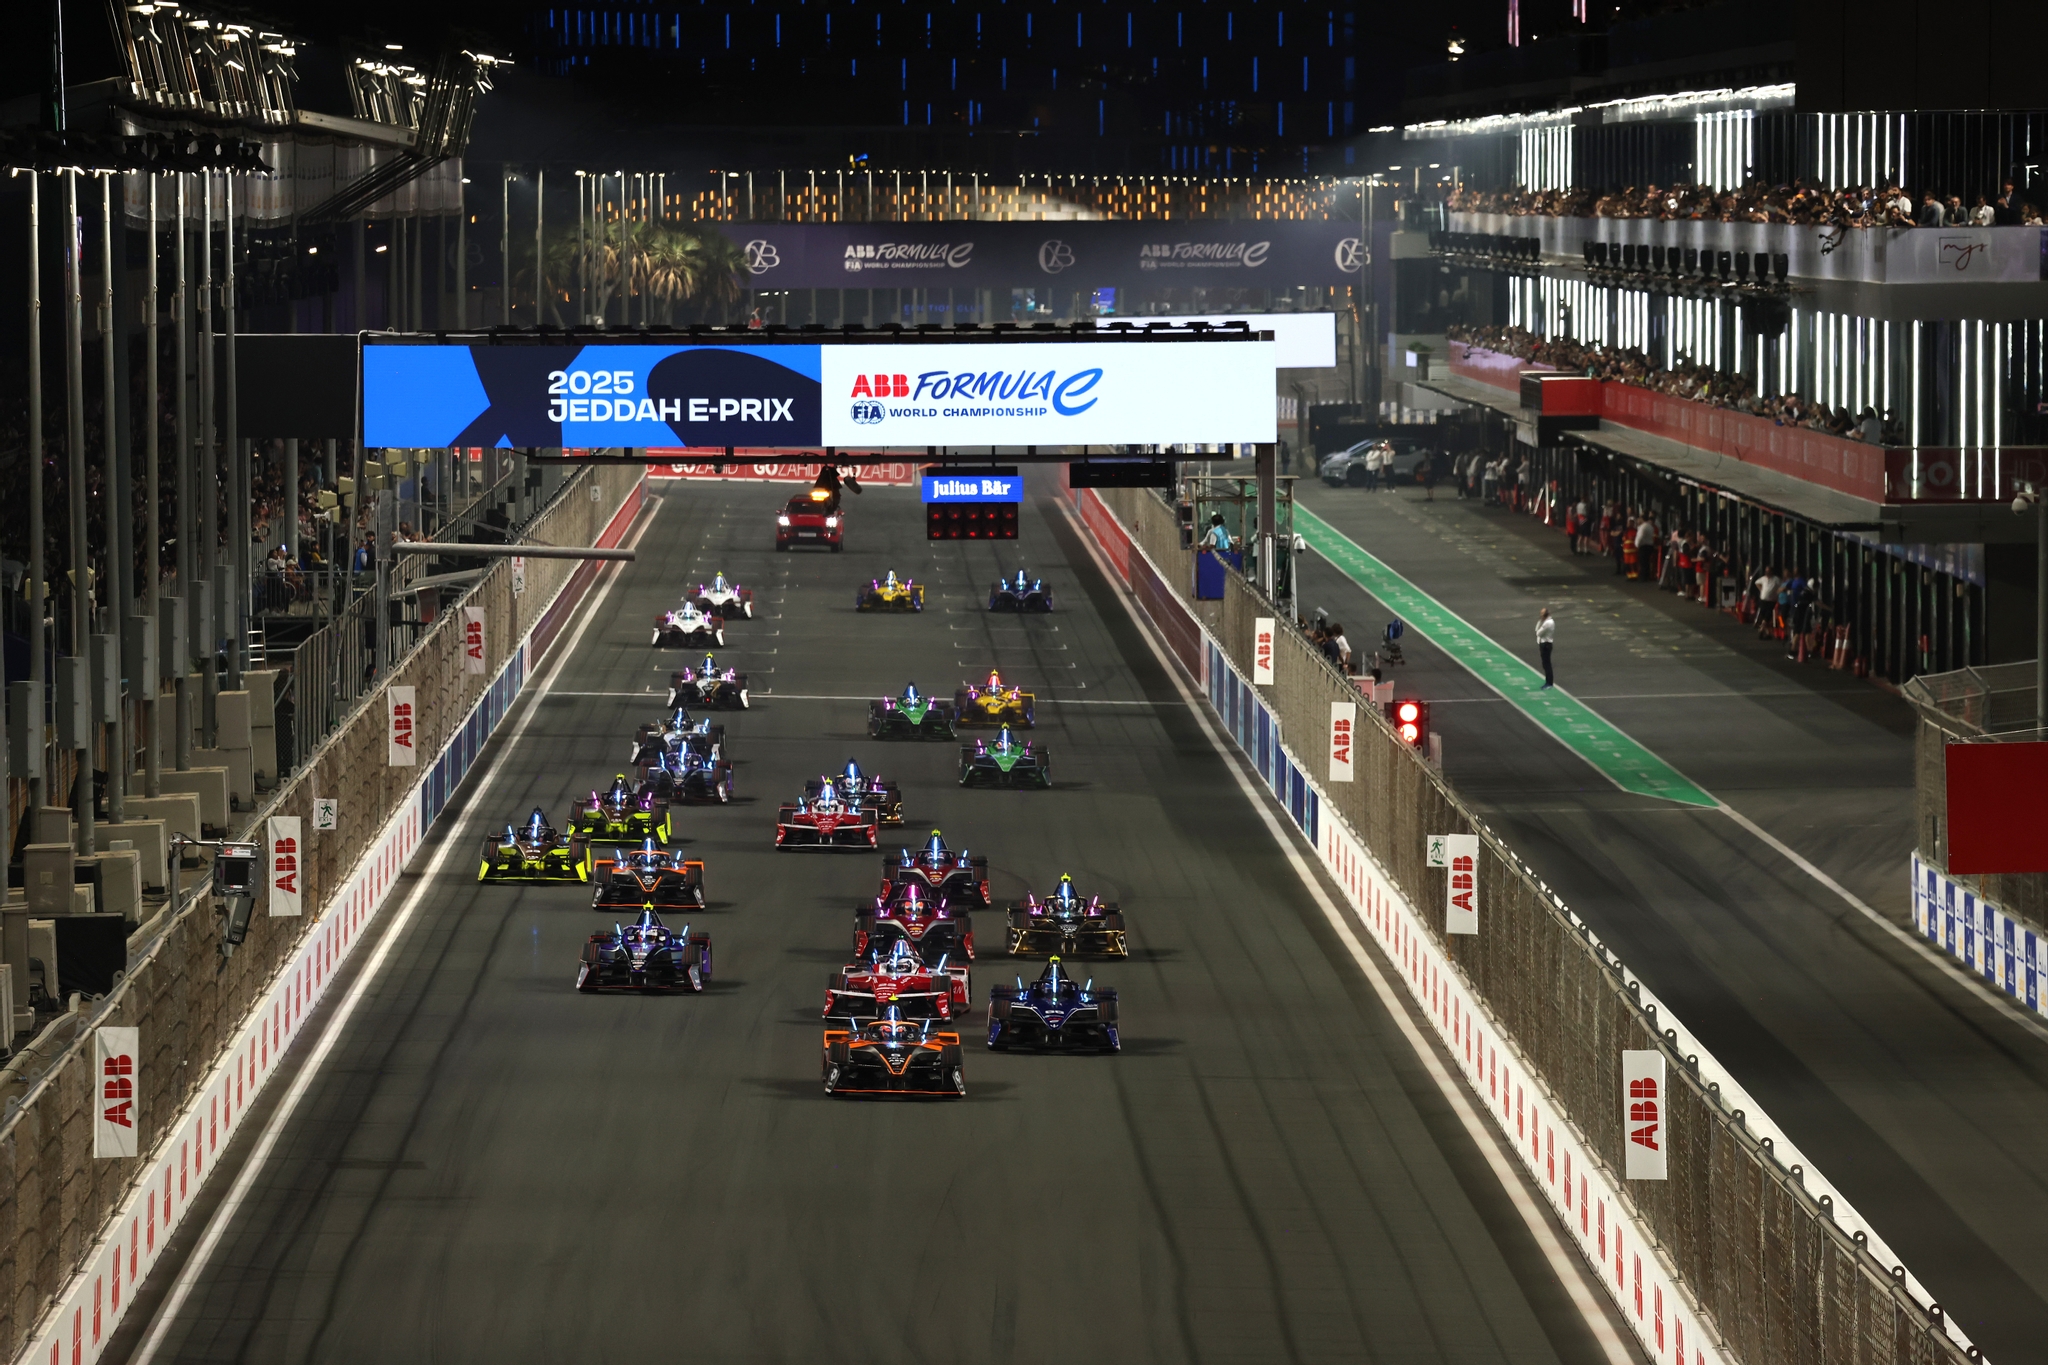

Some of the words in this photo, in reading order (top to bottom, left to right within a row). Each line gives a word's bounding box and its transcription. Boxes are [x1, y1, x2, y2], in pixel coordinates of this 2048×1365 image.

[845, 245, 875, 258] ABB
[877, 243, 947, 259] FORMULA
[864, 261, 890, 269] WORLD
[891, 261, 946, 269] CHAMPIONSHIP
[1140, 244, 1170, 258] ABB
[1171, 242, 1246, 259] FORMULA
[548, 371, 634, 394] 2025
[851, 374, 909, 398] ABB
[913, 370, 1056, 401] FORMULA
[548, 399, 681, 422] JEDDAH
[689, 399, 793, 421] E-PRIX
[889, 408, 937, 417] WORLD
[943, 407, 1047, 417] CHAMPIONSHIP
[933, 480, 978, 498] Julius
[981, 479, 1011, 496] Bär
[467, 621, 482, 659] ABB
[1258, 633, 1270, 670] ABB
[395, 703, 412, 748] ABB
[1334, 719, 1350, 763] ABB
[275, 838, 296, 894] ABB
[1452, 855, 1472, 912] ABB
[104, 1054, 132, 1128] ABB
[1630, 1077, 1659, 1151] ABB
